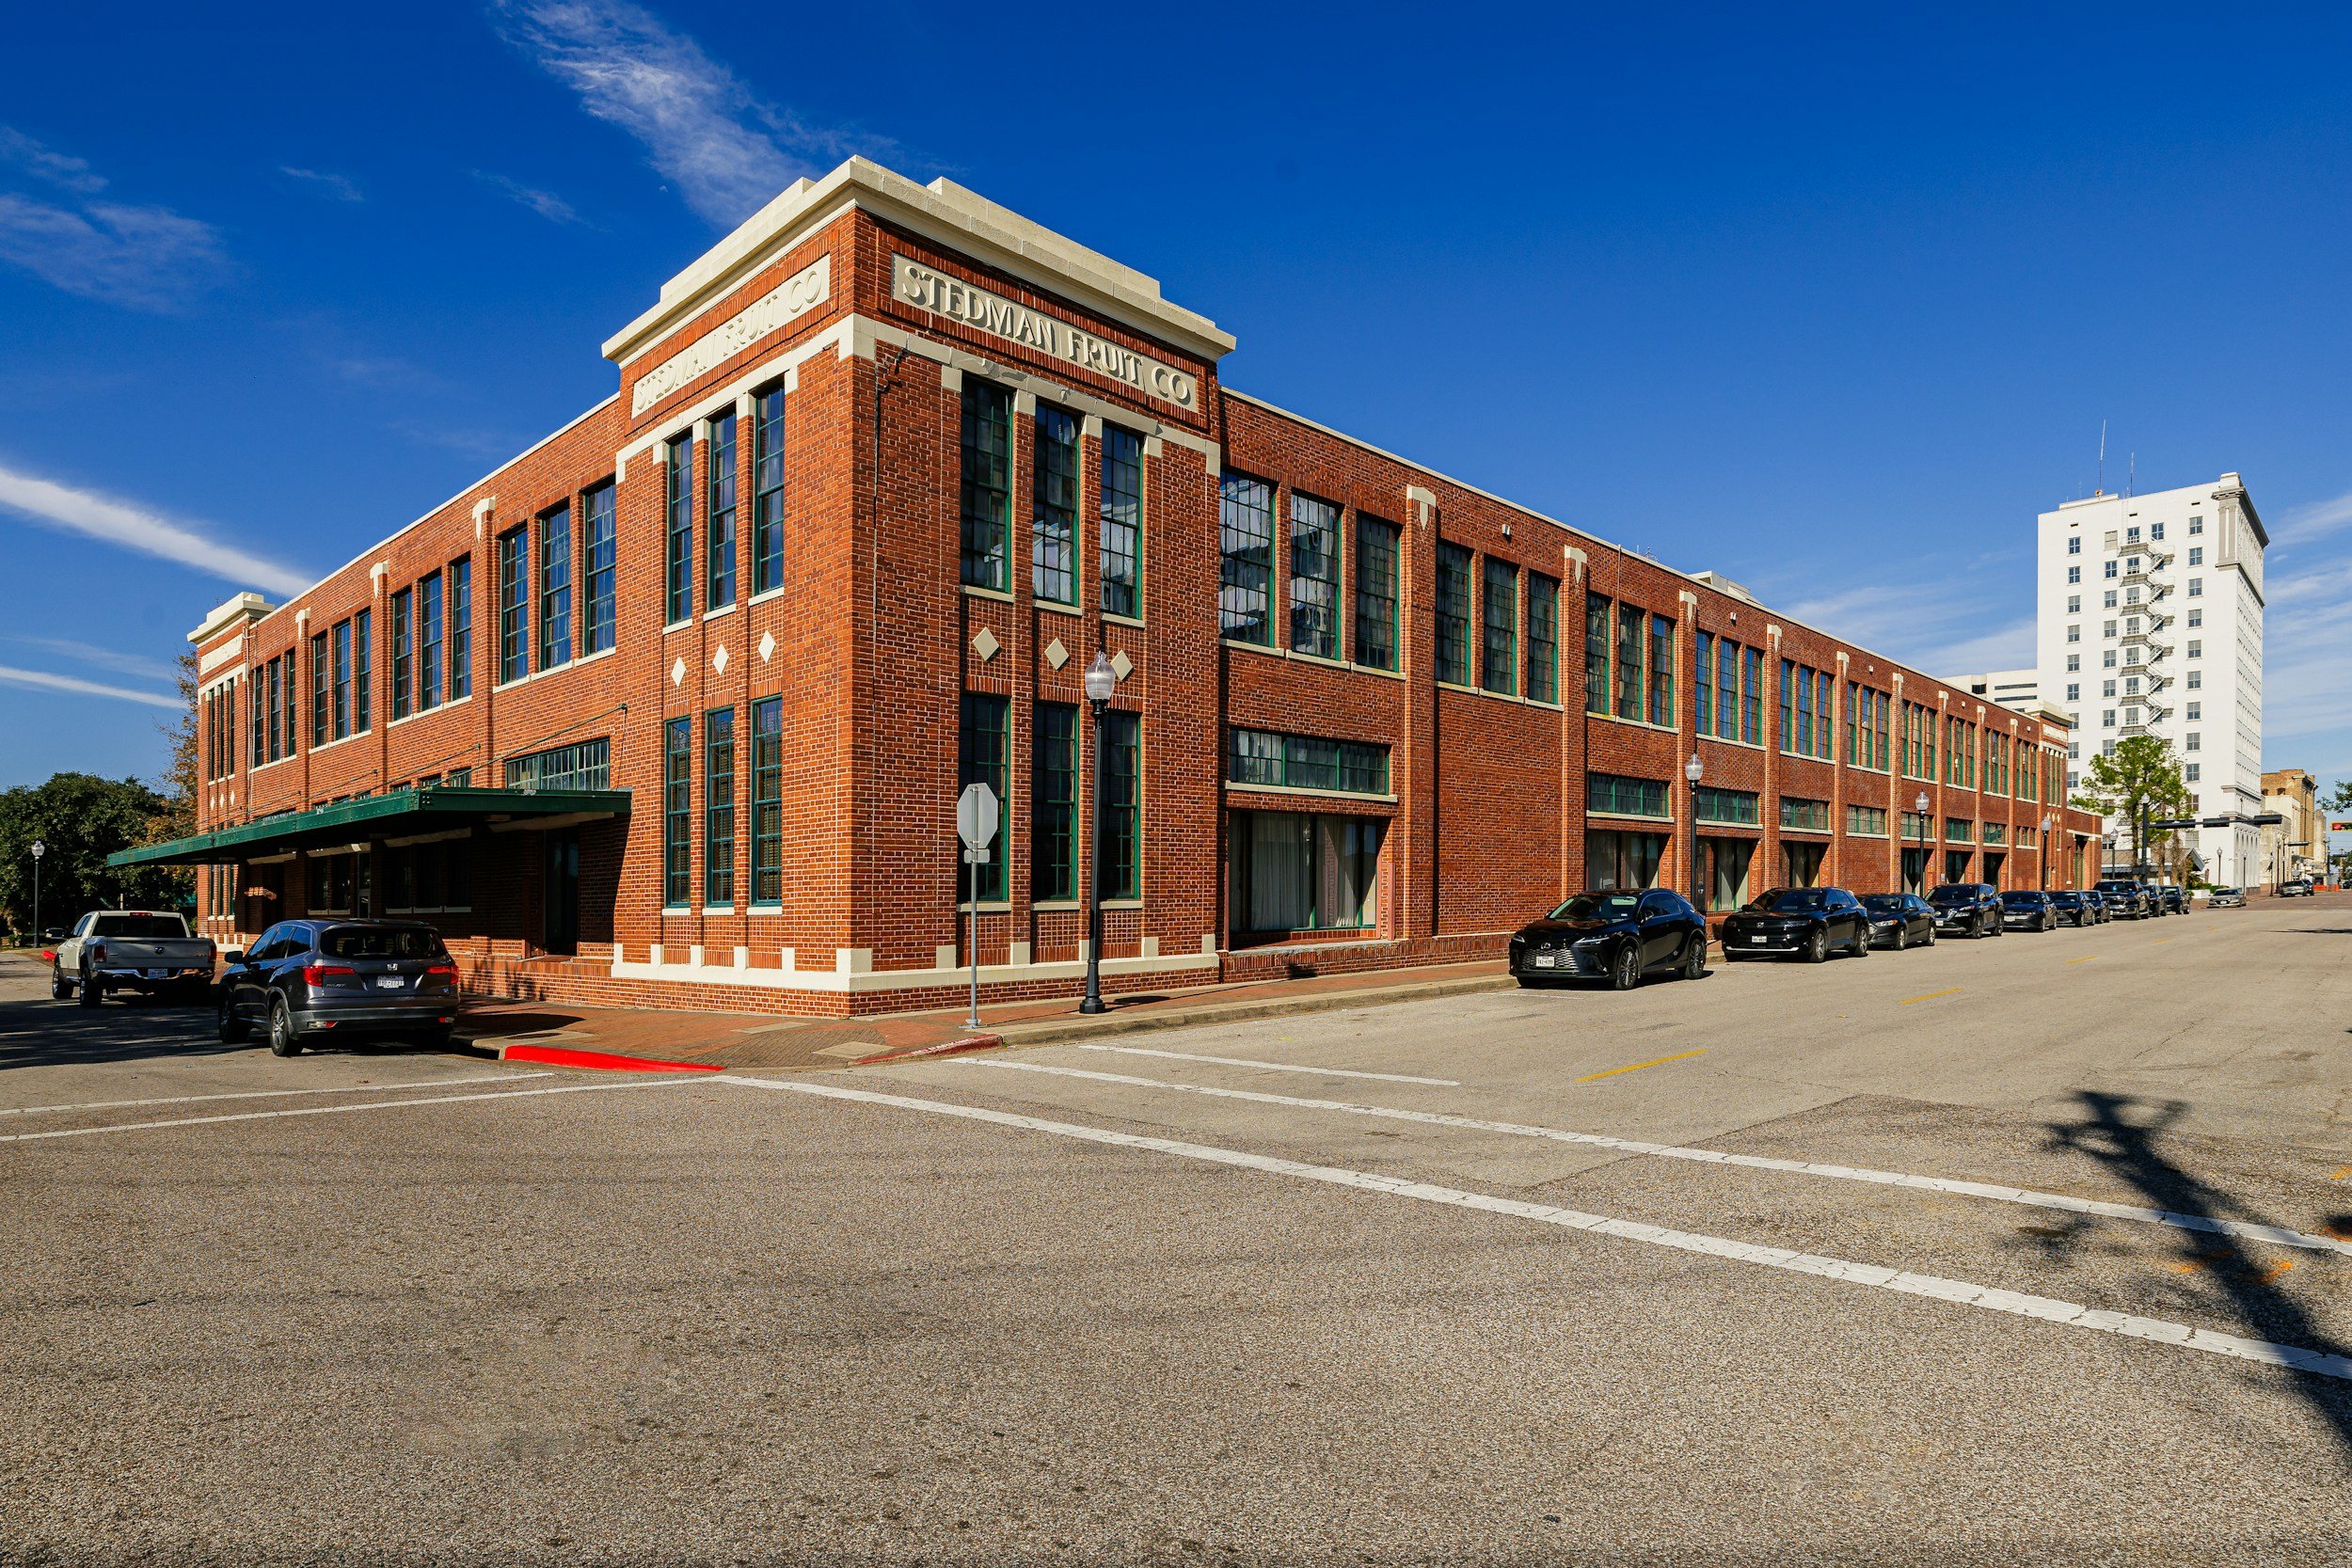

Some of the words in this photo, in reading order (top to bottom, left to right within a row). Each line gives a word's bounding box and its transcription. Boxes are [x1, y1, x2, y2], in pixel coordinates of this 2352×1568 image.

[788, 269, 823, 314] CO
[902, 265, 1055, 354] STEDMAN
[1067, 329, 1143, 385] FRUIT
[1151, 366, 1190, 404] CO
